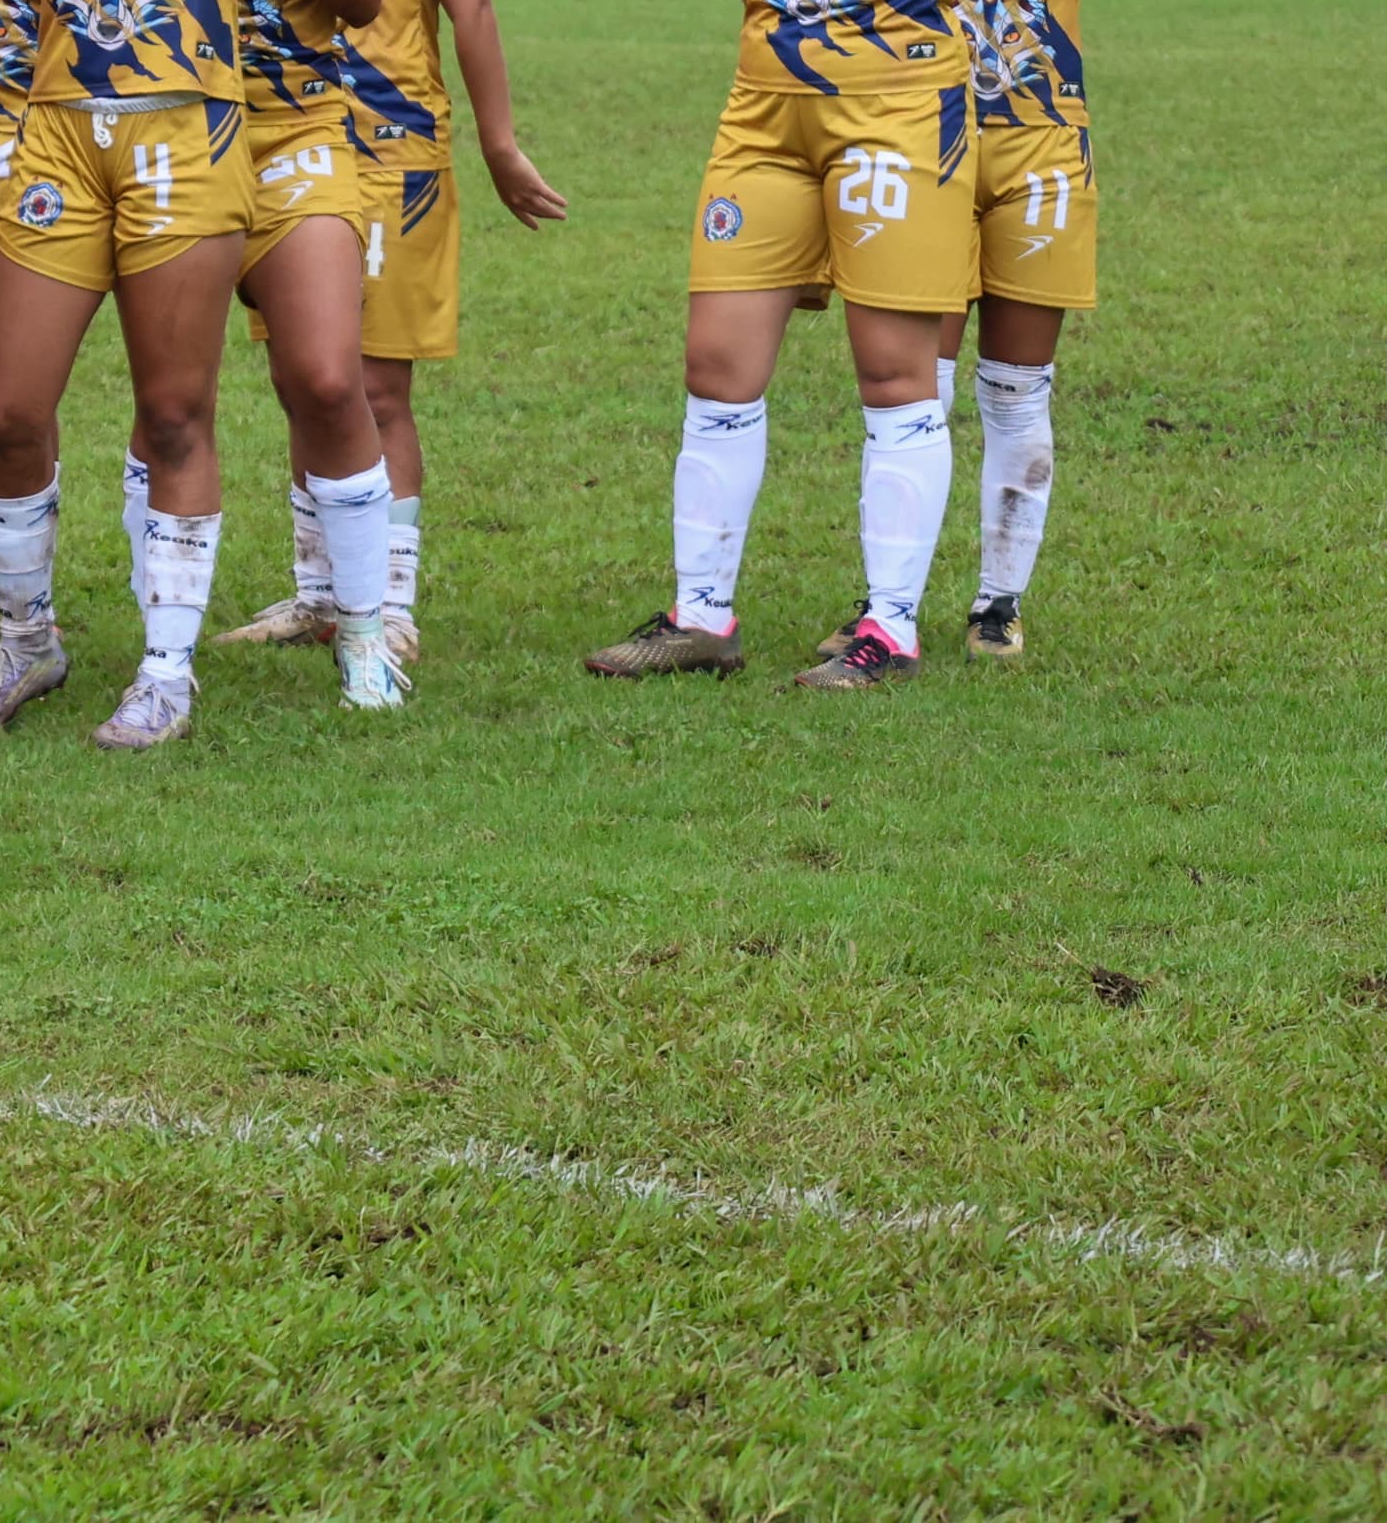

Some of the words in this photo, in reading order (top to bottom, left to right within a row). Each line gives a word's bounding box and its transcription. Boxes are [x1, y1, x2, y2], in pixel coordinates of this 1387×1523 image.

[133, 142, 173, 208] 4
[838, 146, 912, 221] 26
[1024, 168, 1071, 231] 11
